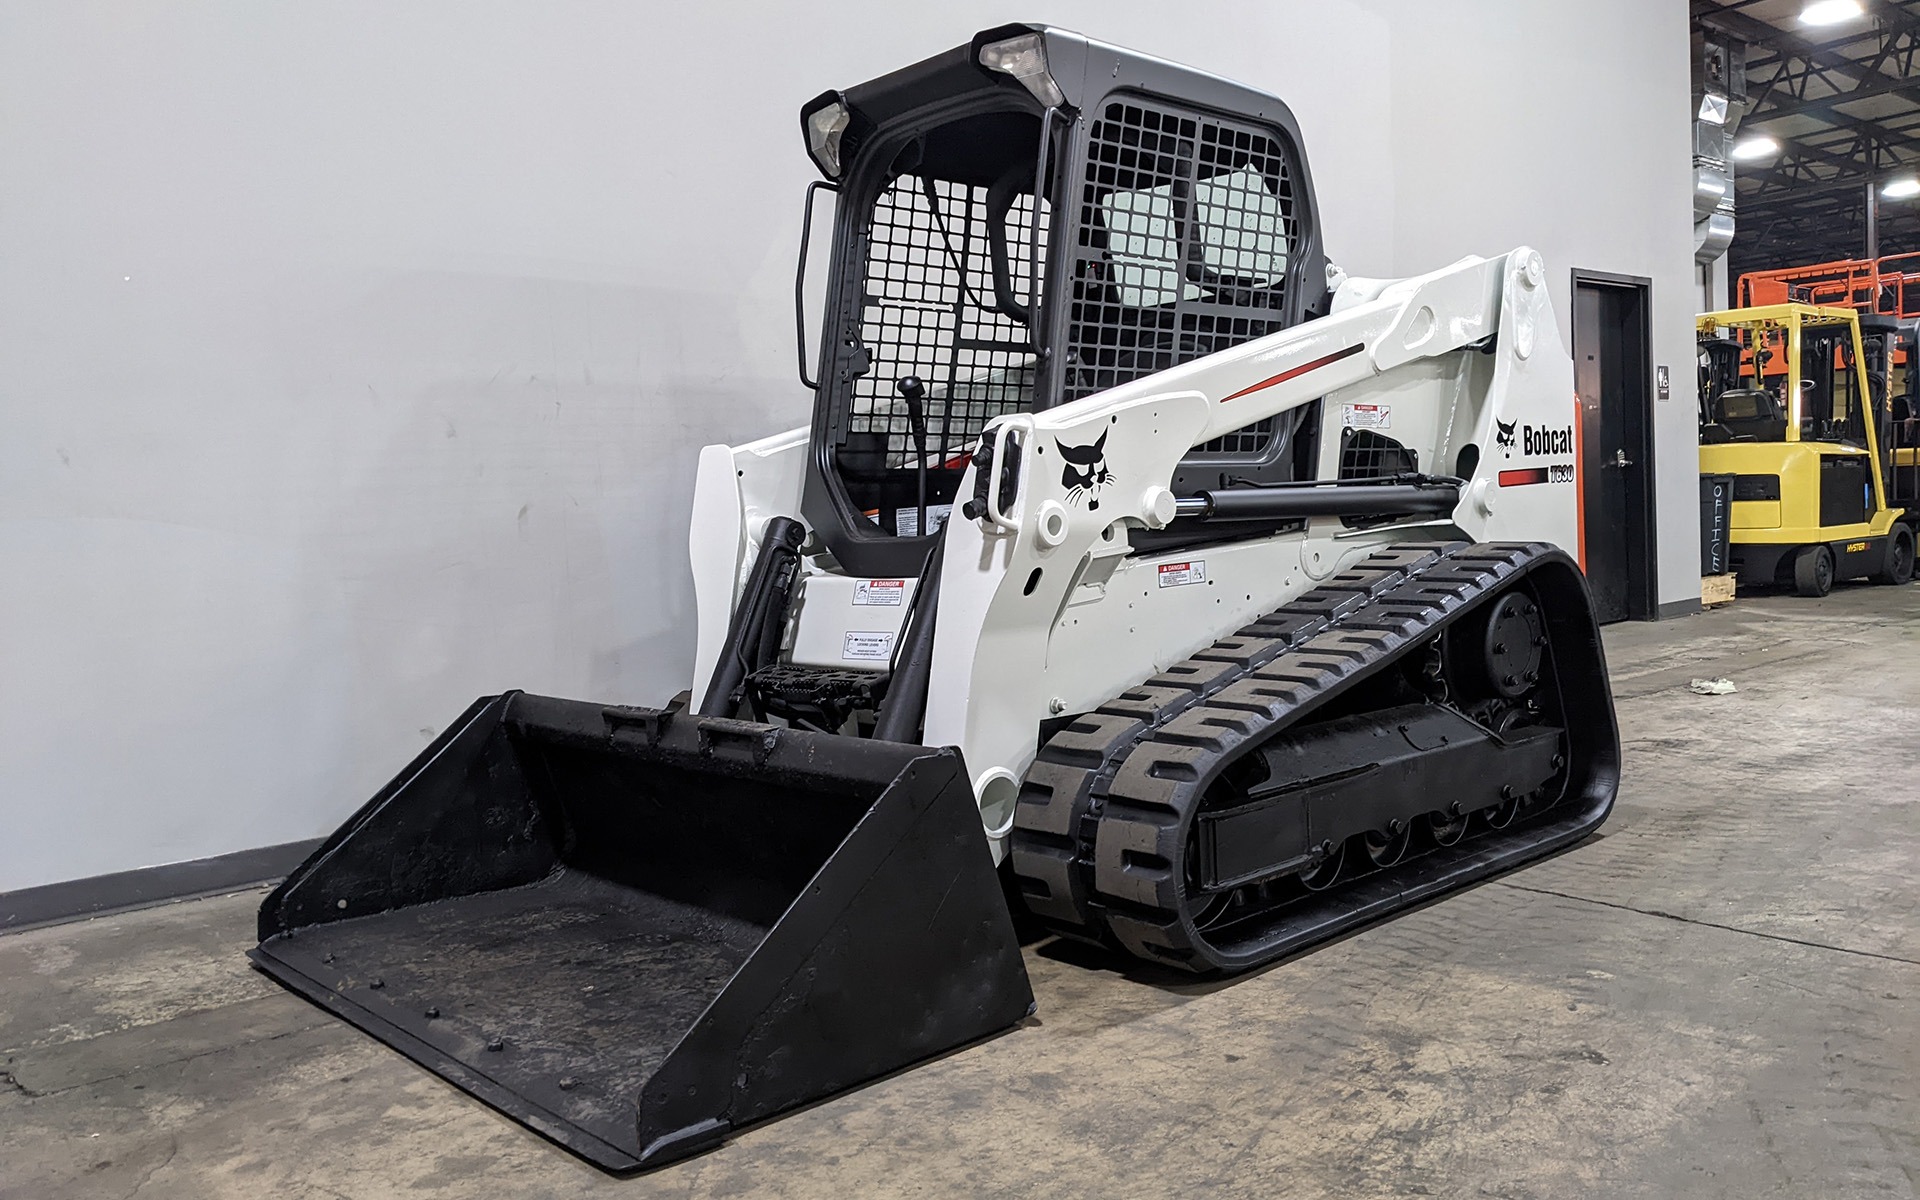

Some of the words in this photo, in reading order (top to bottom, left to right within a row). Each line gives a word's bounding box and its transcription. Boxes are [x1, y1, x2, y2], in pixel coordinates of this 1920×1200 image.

[1523, 425, 1572, 456] Bobcat
[1550, 464, 1574, 483] T630
[1711, 485, 1722, 572] OFFICE
[1846, 542, 1866, 553] HYSTER
